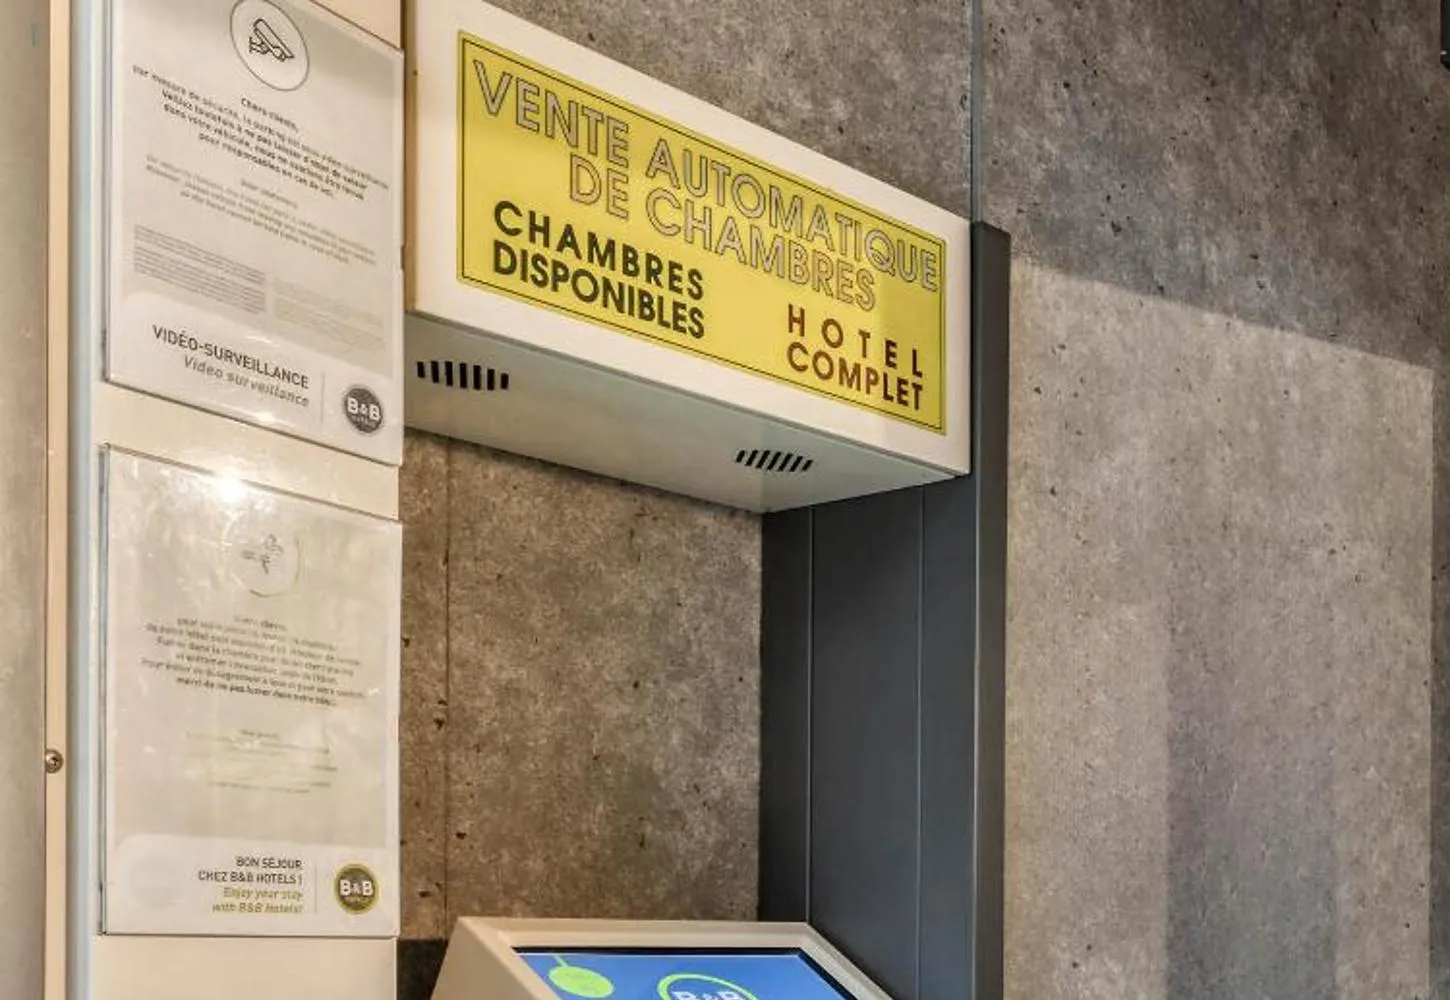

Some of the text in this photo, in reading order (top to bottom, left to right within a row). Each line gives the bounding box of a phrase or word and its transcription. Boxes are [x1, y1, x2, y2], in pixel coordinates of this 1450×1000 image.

[473, 58, 939, 292] VENTE AUTOMATIQUE
[493, 200, 704, 300] CHAMBRES
[569, 155, 877, 312] DE CHAMBRES
[493, 242, 705, 339] DISPONIBLES
[152, 324, 310, 389] VIDÉO-SURVEILLANCE
[786, 341, 923, 411] COMPLET
[197, 869, 228, 882] CHEZ
[229, 870, 254, 883] B&B
[235, 855, 260, 867] BON
[339, 879, 374, 896] B&B
